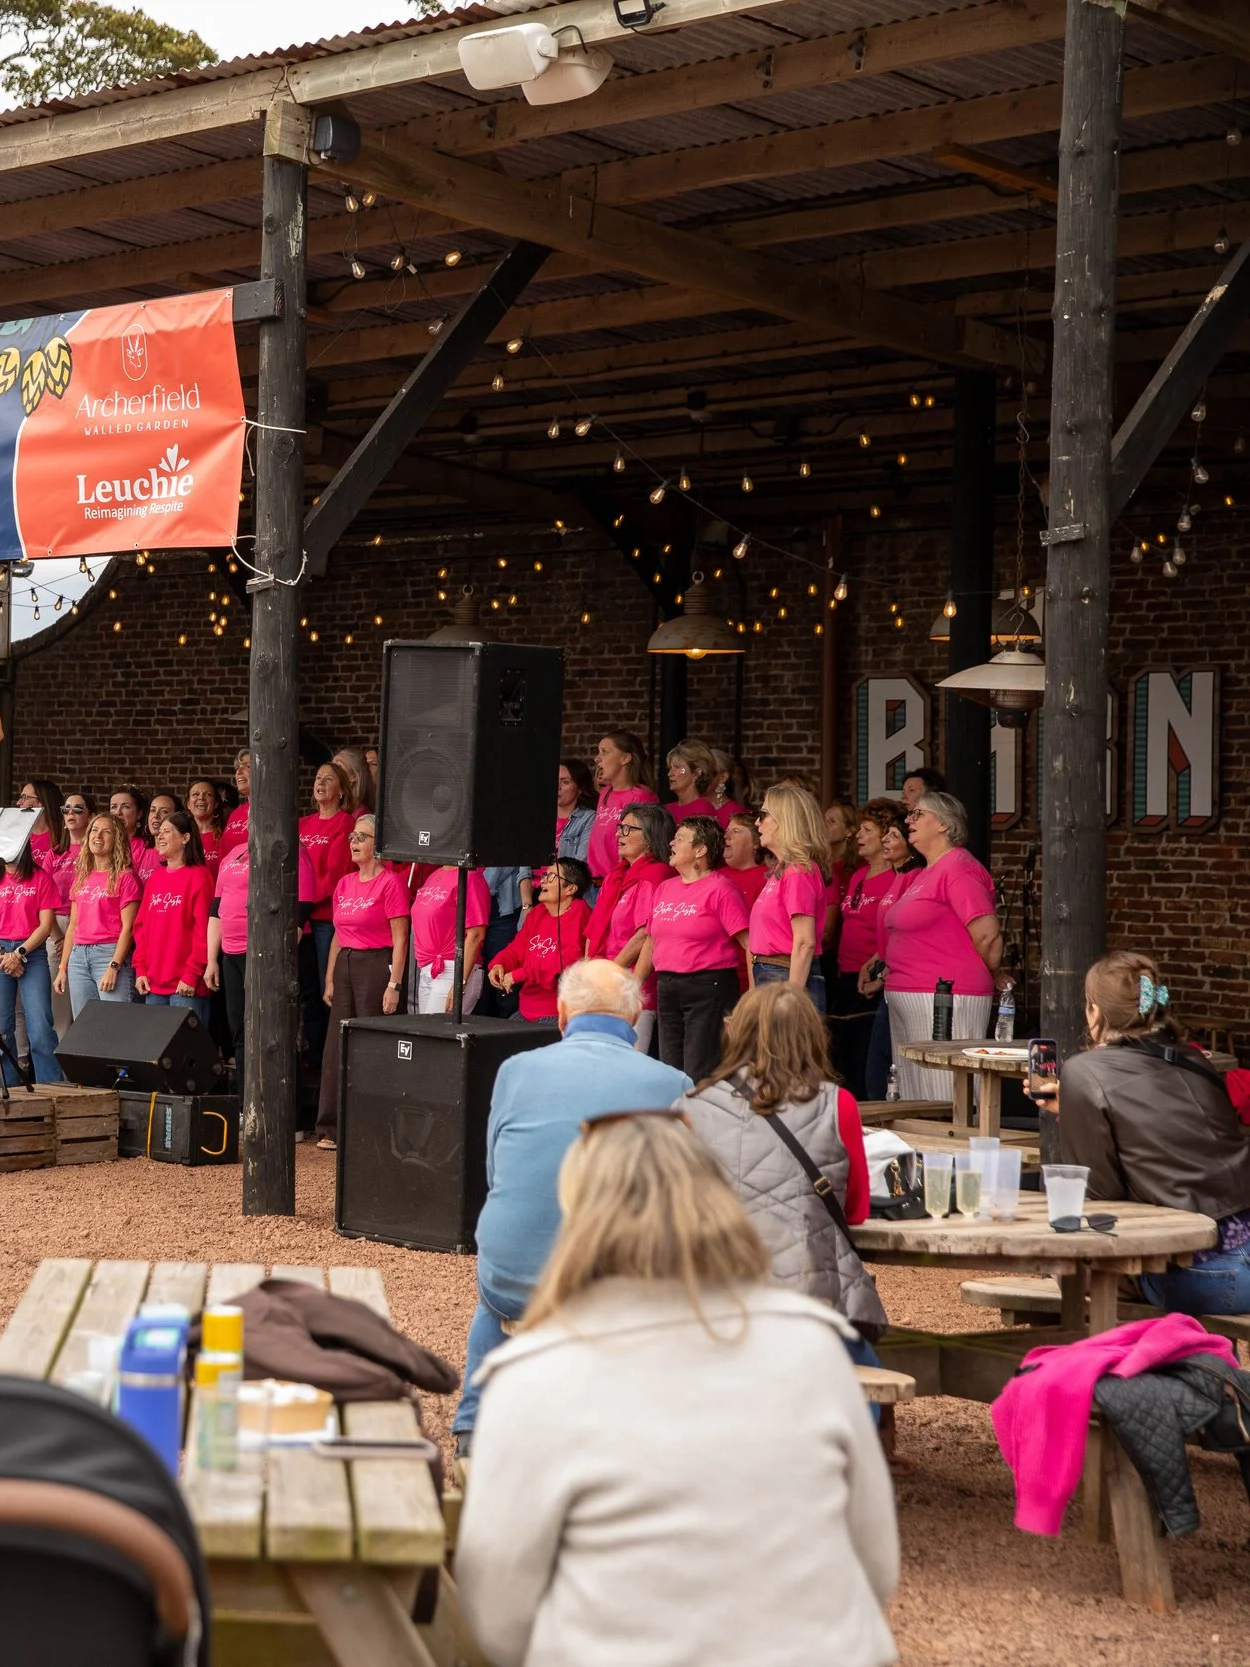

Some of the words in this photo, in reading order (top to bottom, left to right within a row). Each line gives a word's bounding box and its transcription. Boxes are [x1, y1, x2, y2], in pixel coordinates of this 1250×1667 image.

[76, 383, 200, 419] Archerfield
[84, 423, 132, 436] WALLED
[136, 419, 189, 432] GARDEN
[77, 467, 194, 504] Leuchie
[84, 504, 148, 520] Reimagining
[149, 500, 184, 516] Respite
[857, 670, 1215, 828] BN
